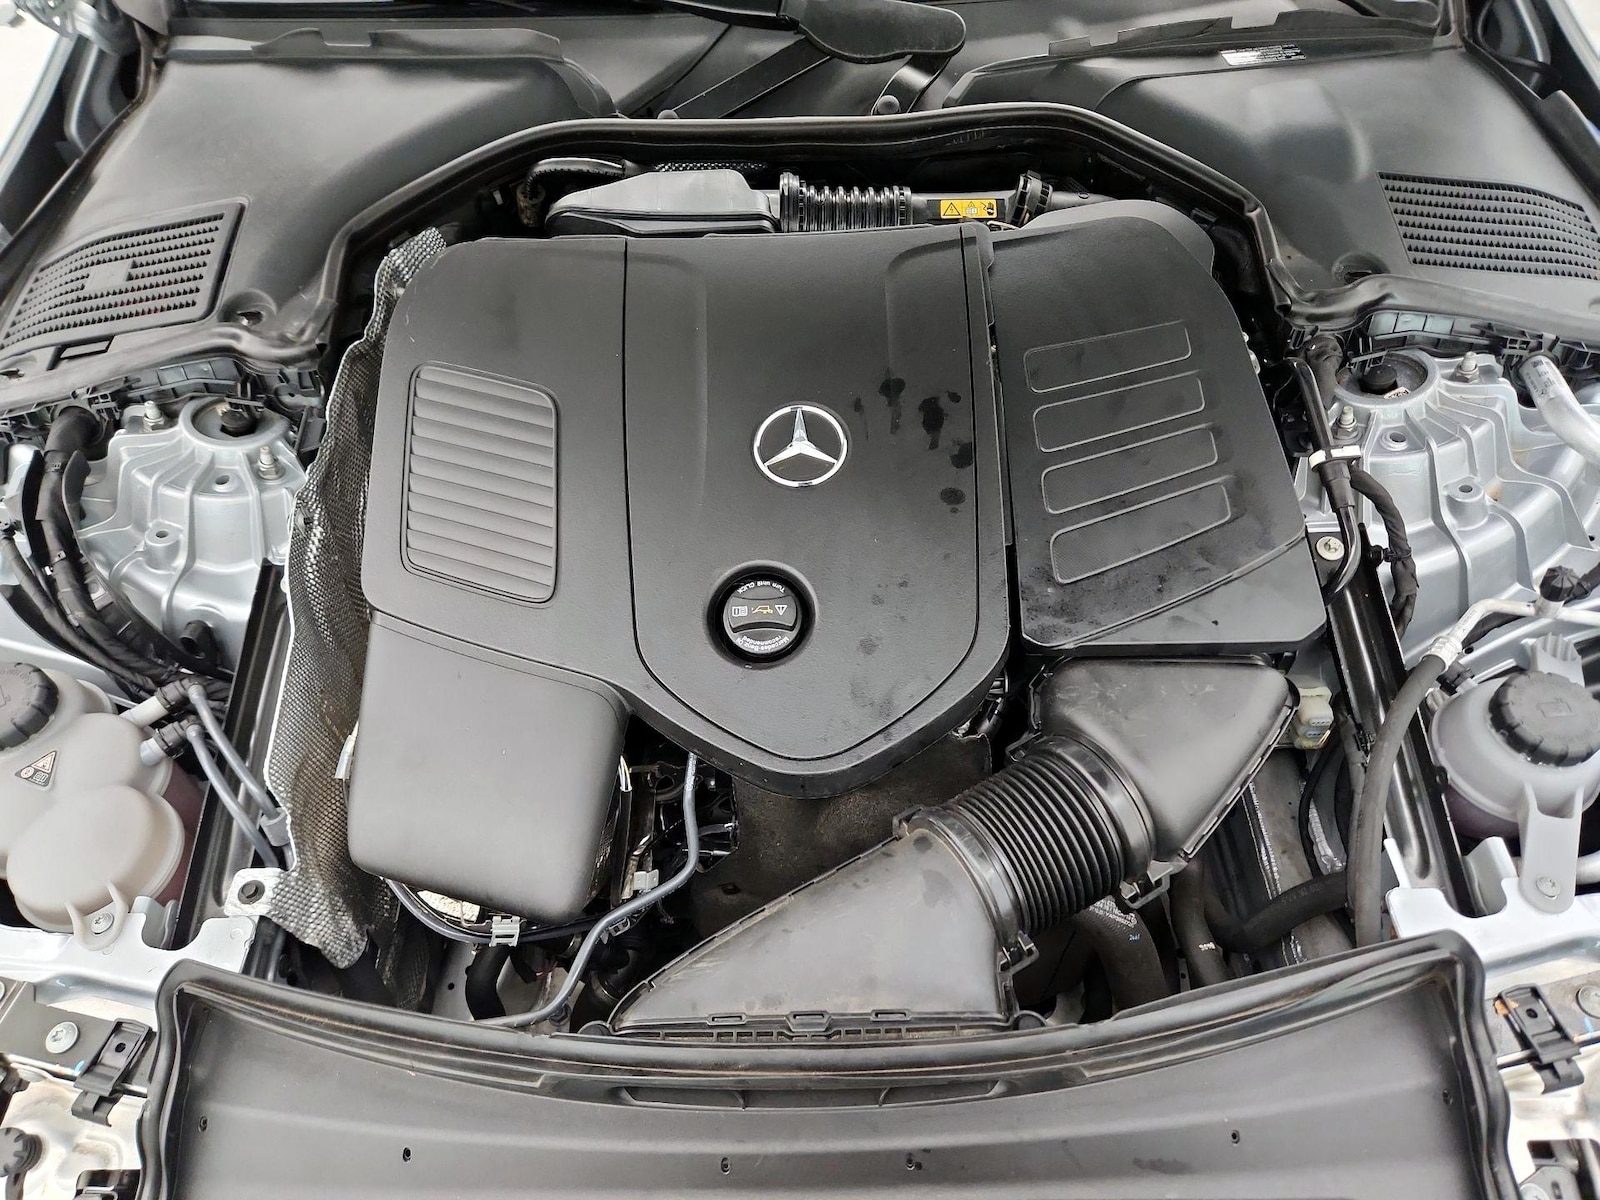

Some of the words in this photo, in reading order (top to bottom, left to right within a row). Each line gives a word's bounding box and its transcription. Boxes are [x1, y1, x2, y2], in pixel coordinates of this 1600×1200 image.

[737, 582, 755, 594] CLICK
[772, 582, 785, 593] Turn
[742, 635, 781, 646] recommended
[743, 635, 790, 652] Mercedes-Benz
